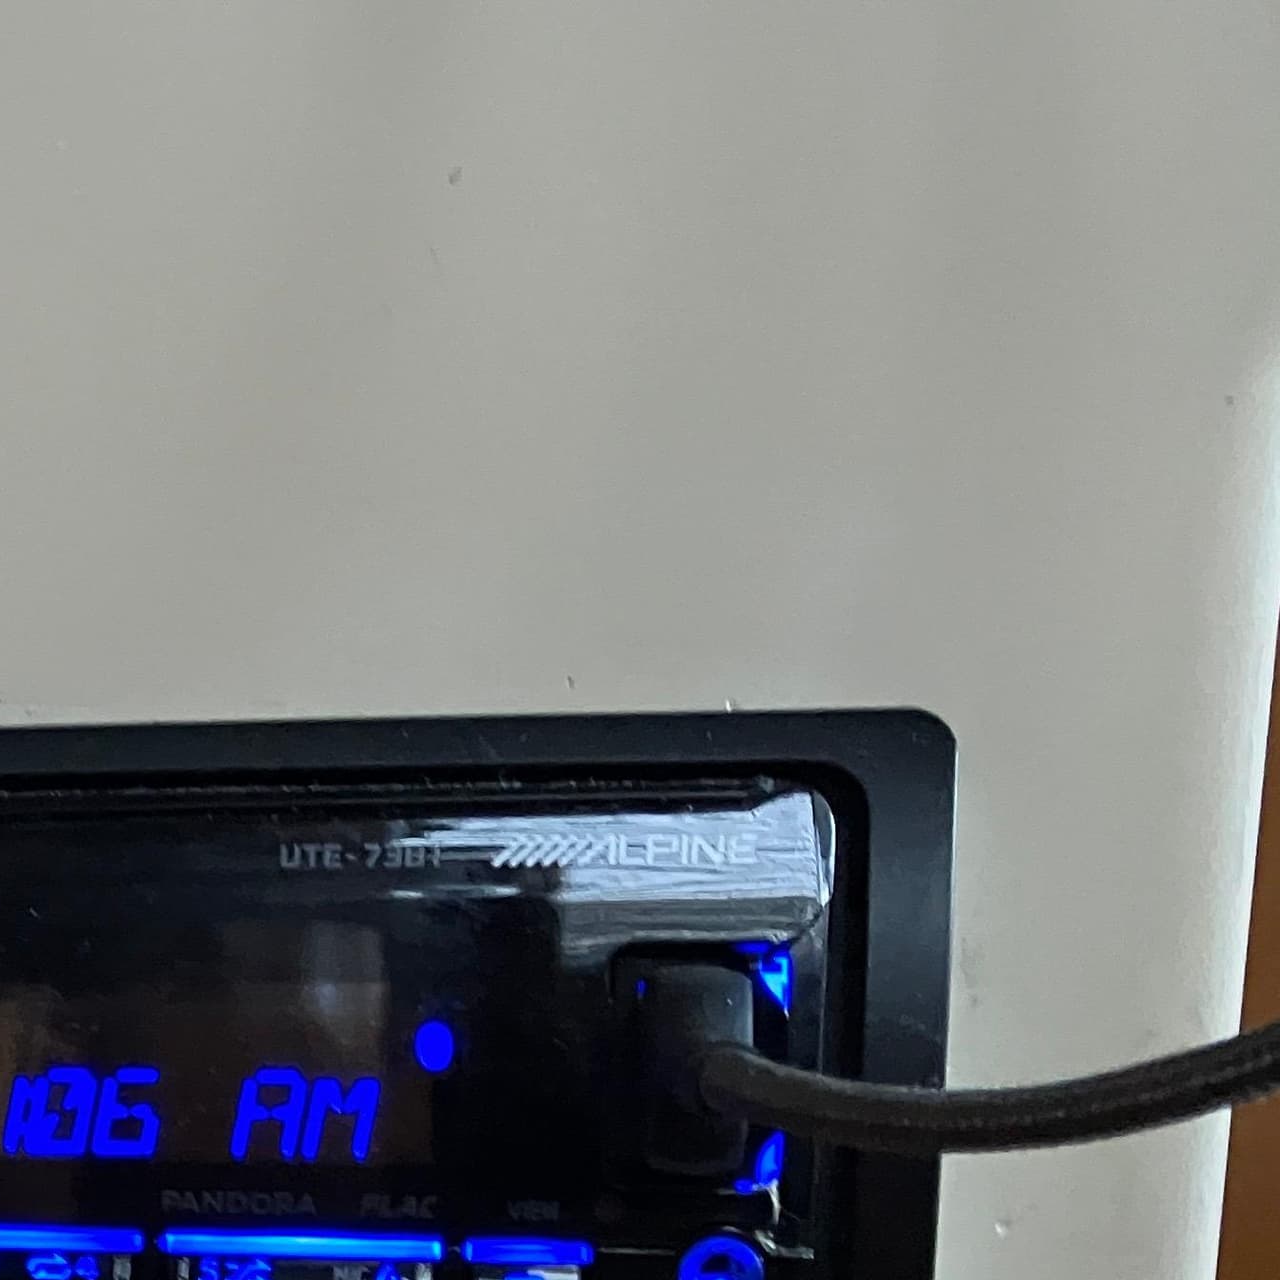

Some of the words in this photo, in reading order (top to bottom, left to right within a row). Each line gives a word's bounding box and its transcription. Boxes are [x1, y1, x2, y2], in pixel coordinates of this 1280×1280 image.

[578, 832, 759, 866] ALPINE
[230, 1067, 382, 1161] AM
[160, 1190, 317, 1217] PANDORA
